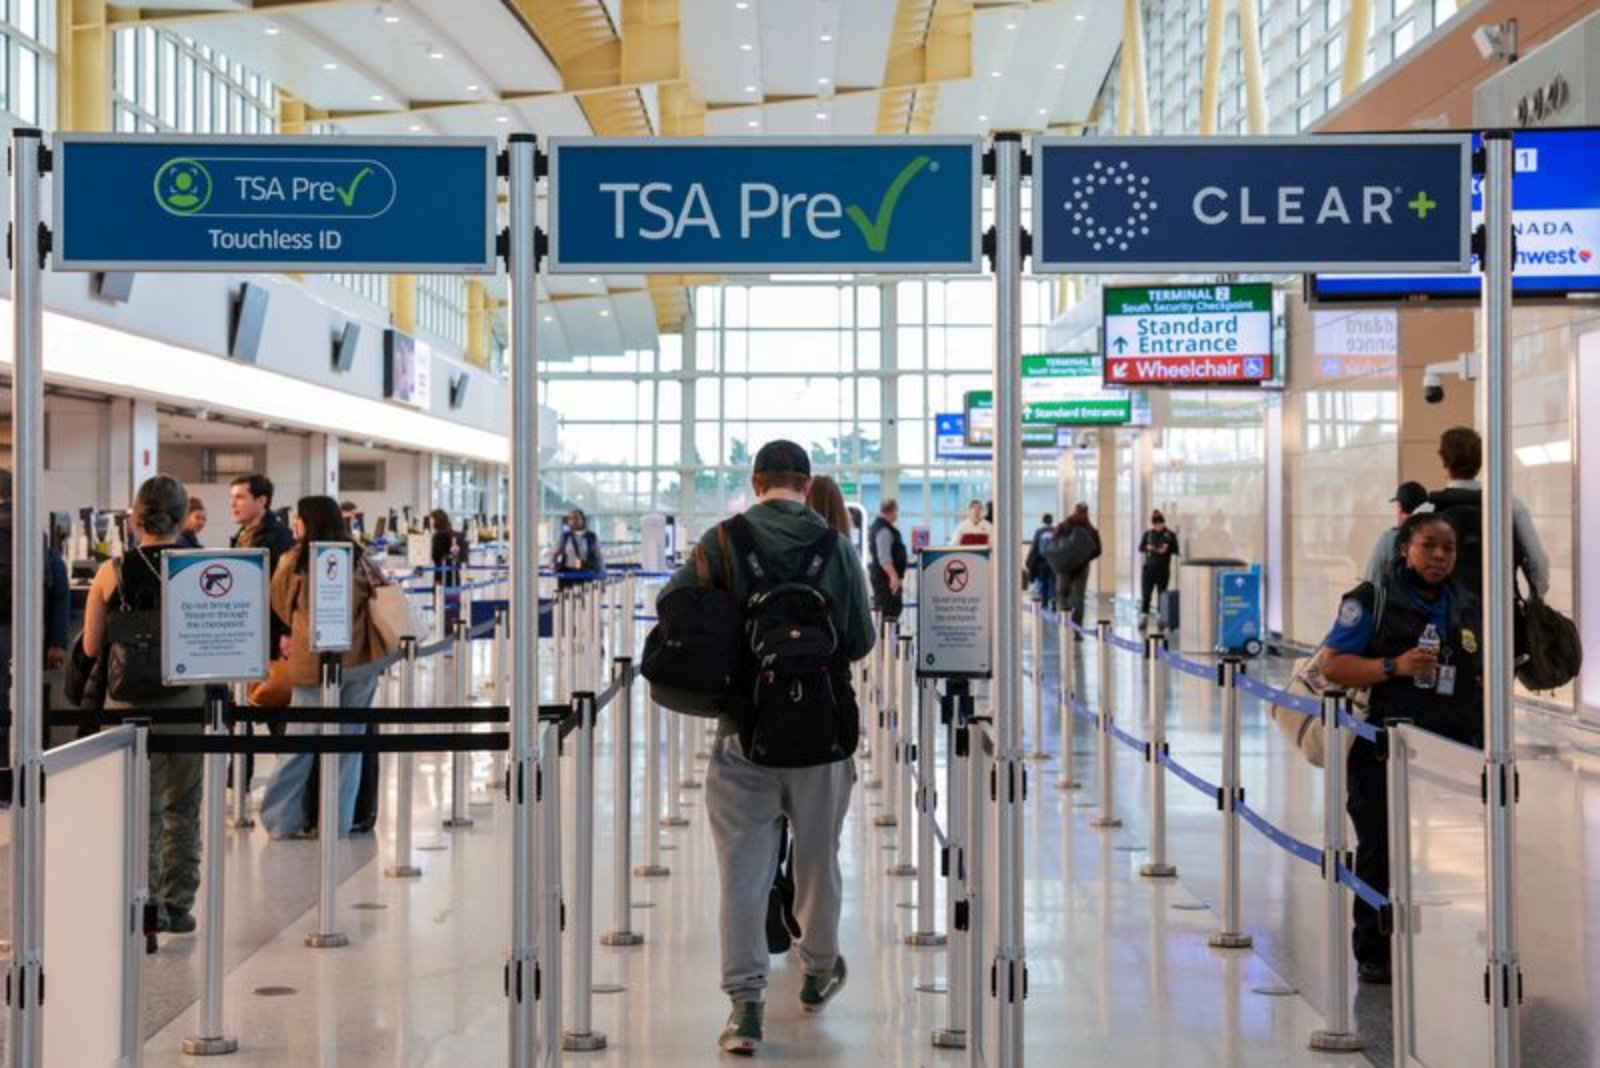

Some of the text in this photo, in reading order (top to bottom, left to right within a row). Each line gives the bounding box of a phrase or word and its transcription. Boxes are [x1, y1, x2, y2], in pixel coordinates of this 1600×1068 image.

[234, 176, 335, 201] TSA Pre
[599, 182, 843, 240] TSA Pre
[1514, 222, 1574, 235] NADA
[208, 229, 342, 249] Touchless ID
[1148, 288, 1213, 301] TERMINAL
[1121, 299, 1253, 314] South Security Checkpoint
[1137, 315, 1237, 335] Standard
[1139, 337, 1238, 353] Entrance
[1136, 358, 1240, 379] Wheelchair
[1035, 406, 1125, 418] Standard Entrance
